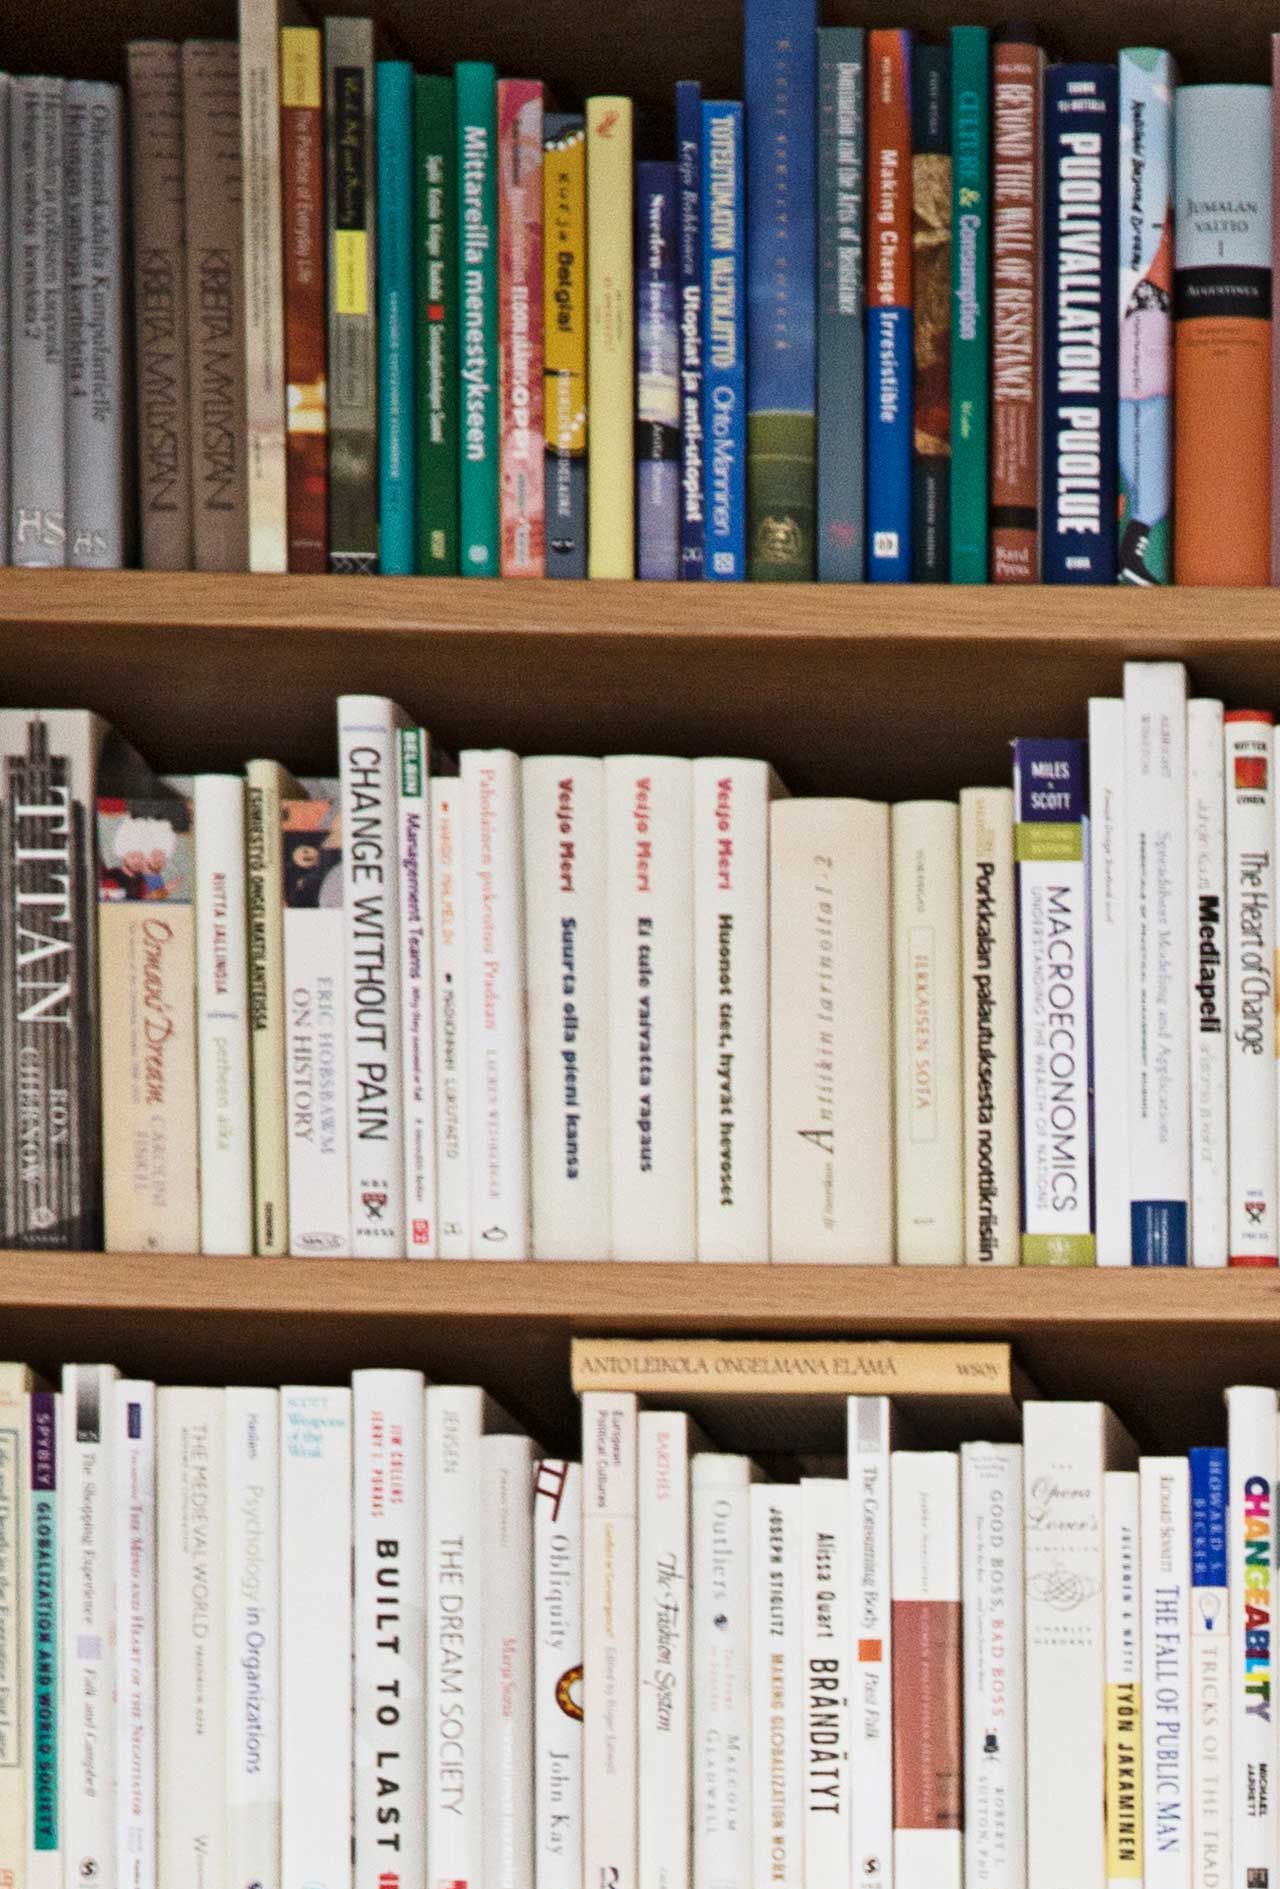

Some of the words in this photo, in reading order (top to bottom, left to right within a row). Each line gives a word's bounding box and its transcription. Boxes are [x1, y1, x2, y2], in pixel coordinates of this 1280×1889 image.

[464, 126, 487, 263] Mittareilla
[878, 150, 898, 223] Making
[878, 231, 898, 304] Change
[1058, 133, 1102, 391] PUOLIVALLATON
[463, 271, 485, 460] menestykseen
[879, 312, 897, 423] Irresistible
[1058, 406, 1101, 534] PUOLUE
[350, 747, 379, 883] CHANGE
[13, 786, 71, 1027] TITAN
[354, 896, 385, 1051] WITHOUT
[976, 862, 994, 969] Porkkalan
[1196, 896, 1221, 1032] Mediapeli
[357, 1063, 388, 1141] PAIN
[971, 974, 994, 1124] palautuksesta
[1048, 886, 1076, 1212] MACROECONOMICS
[977, 1129, 997, 1262] noottikriisiin
[376, 1539, 399, 1655] BUILT
[817, 1590, 837, 1638] Quart
[1244, 1476, 1271, 1722] CHANGEABILITY
[376, 1681, 399, 1725] TO
[810, 1659, 846, 1815] BRÄNDÄTYT
[376, 1751, 399, 1853] LAST
